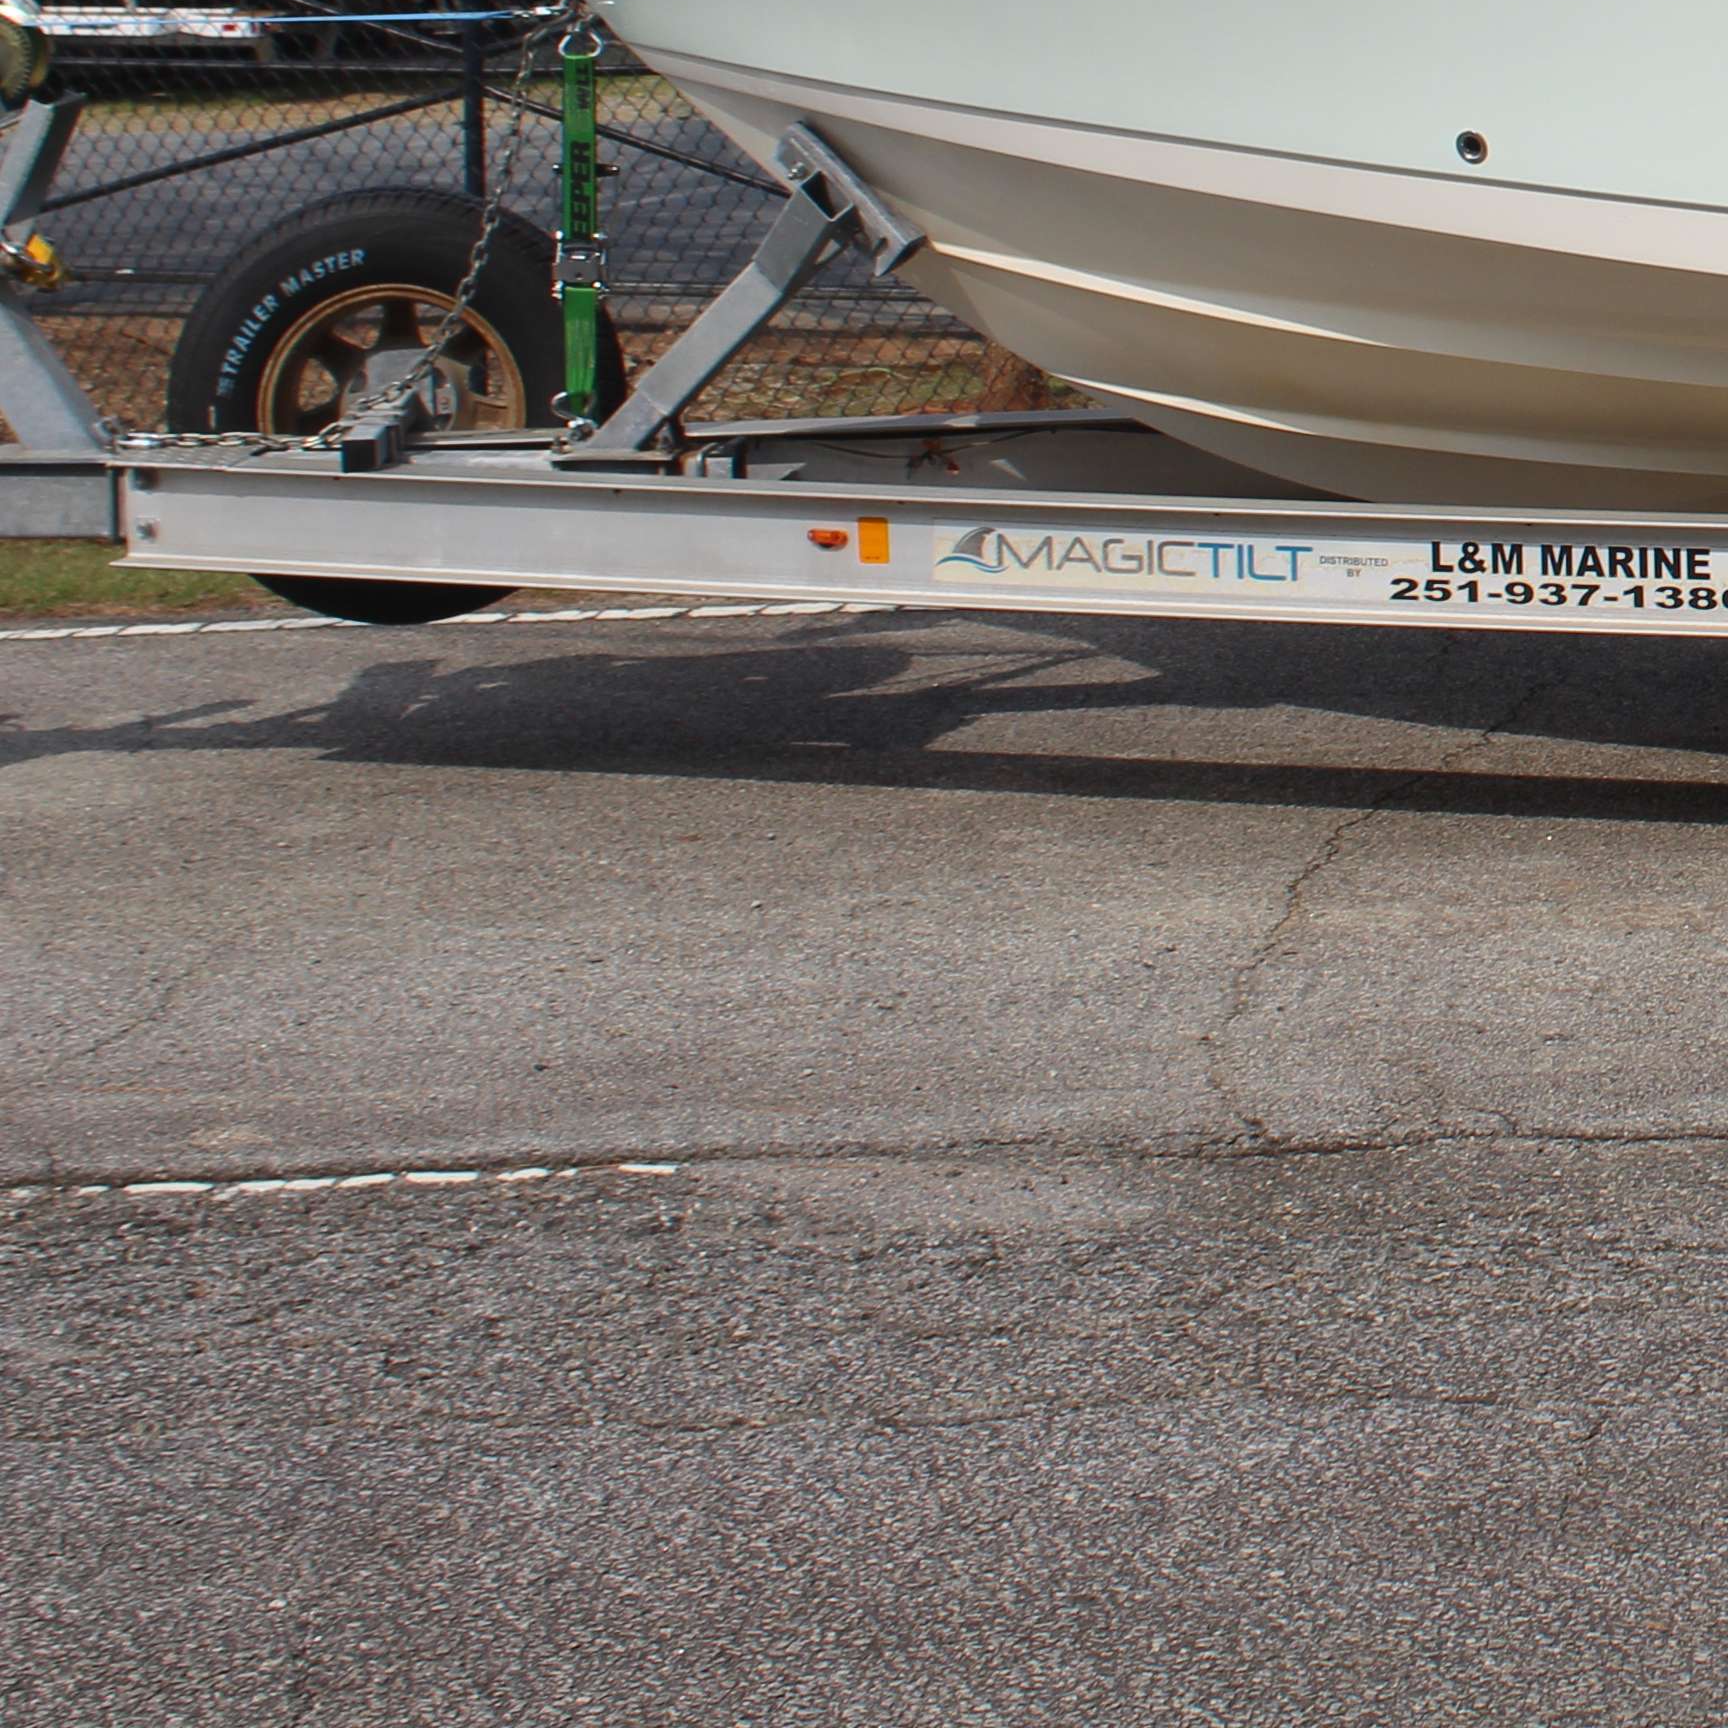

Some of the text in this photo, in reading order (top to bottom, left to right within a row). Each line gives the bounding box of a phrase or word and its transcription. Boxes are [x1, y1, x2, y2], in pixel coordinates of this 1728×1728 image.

[570, 140, 591, 240] EEPER
[221, 248, 367, 375] TRAILER MASTER
[997, 533, 1313, 582] MAGICTILT
[1319, 555, 1389, 567] DISTRIBUTED
[1346, 568, 1361, 578] BY
[1430, 540, 1712, 581] L&M MARINE
